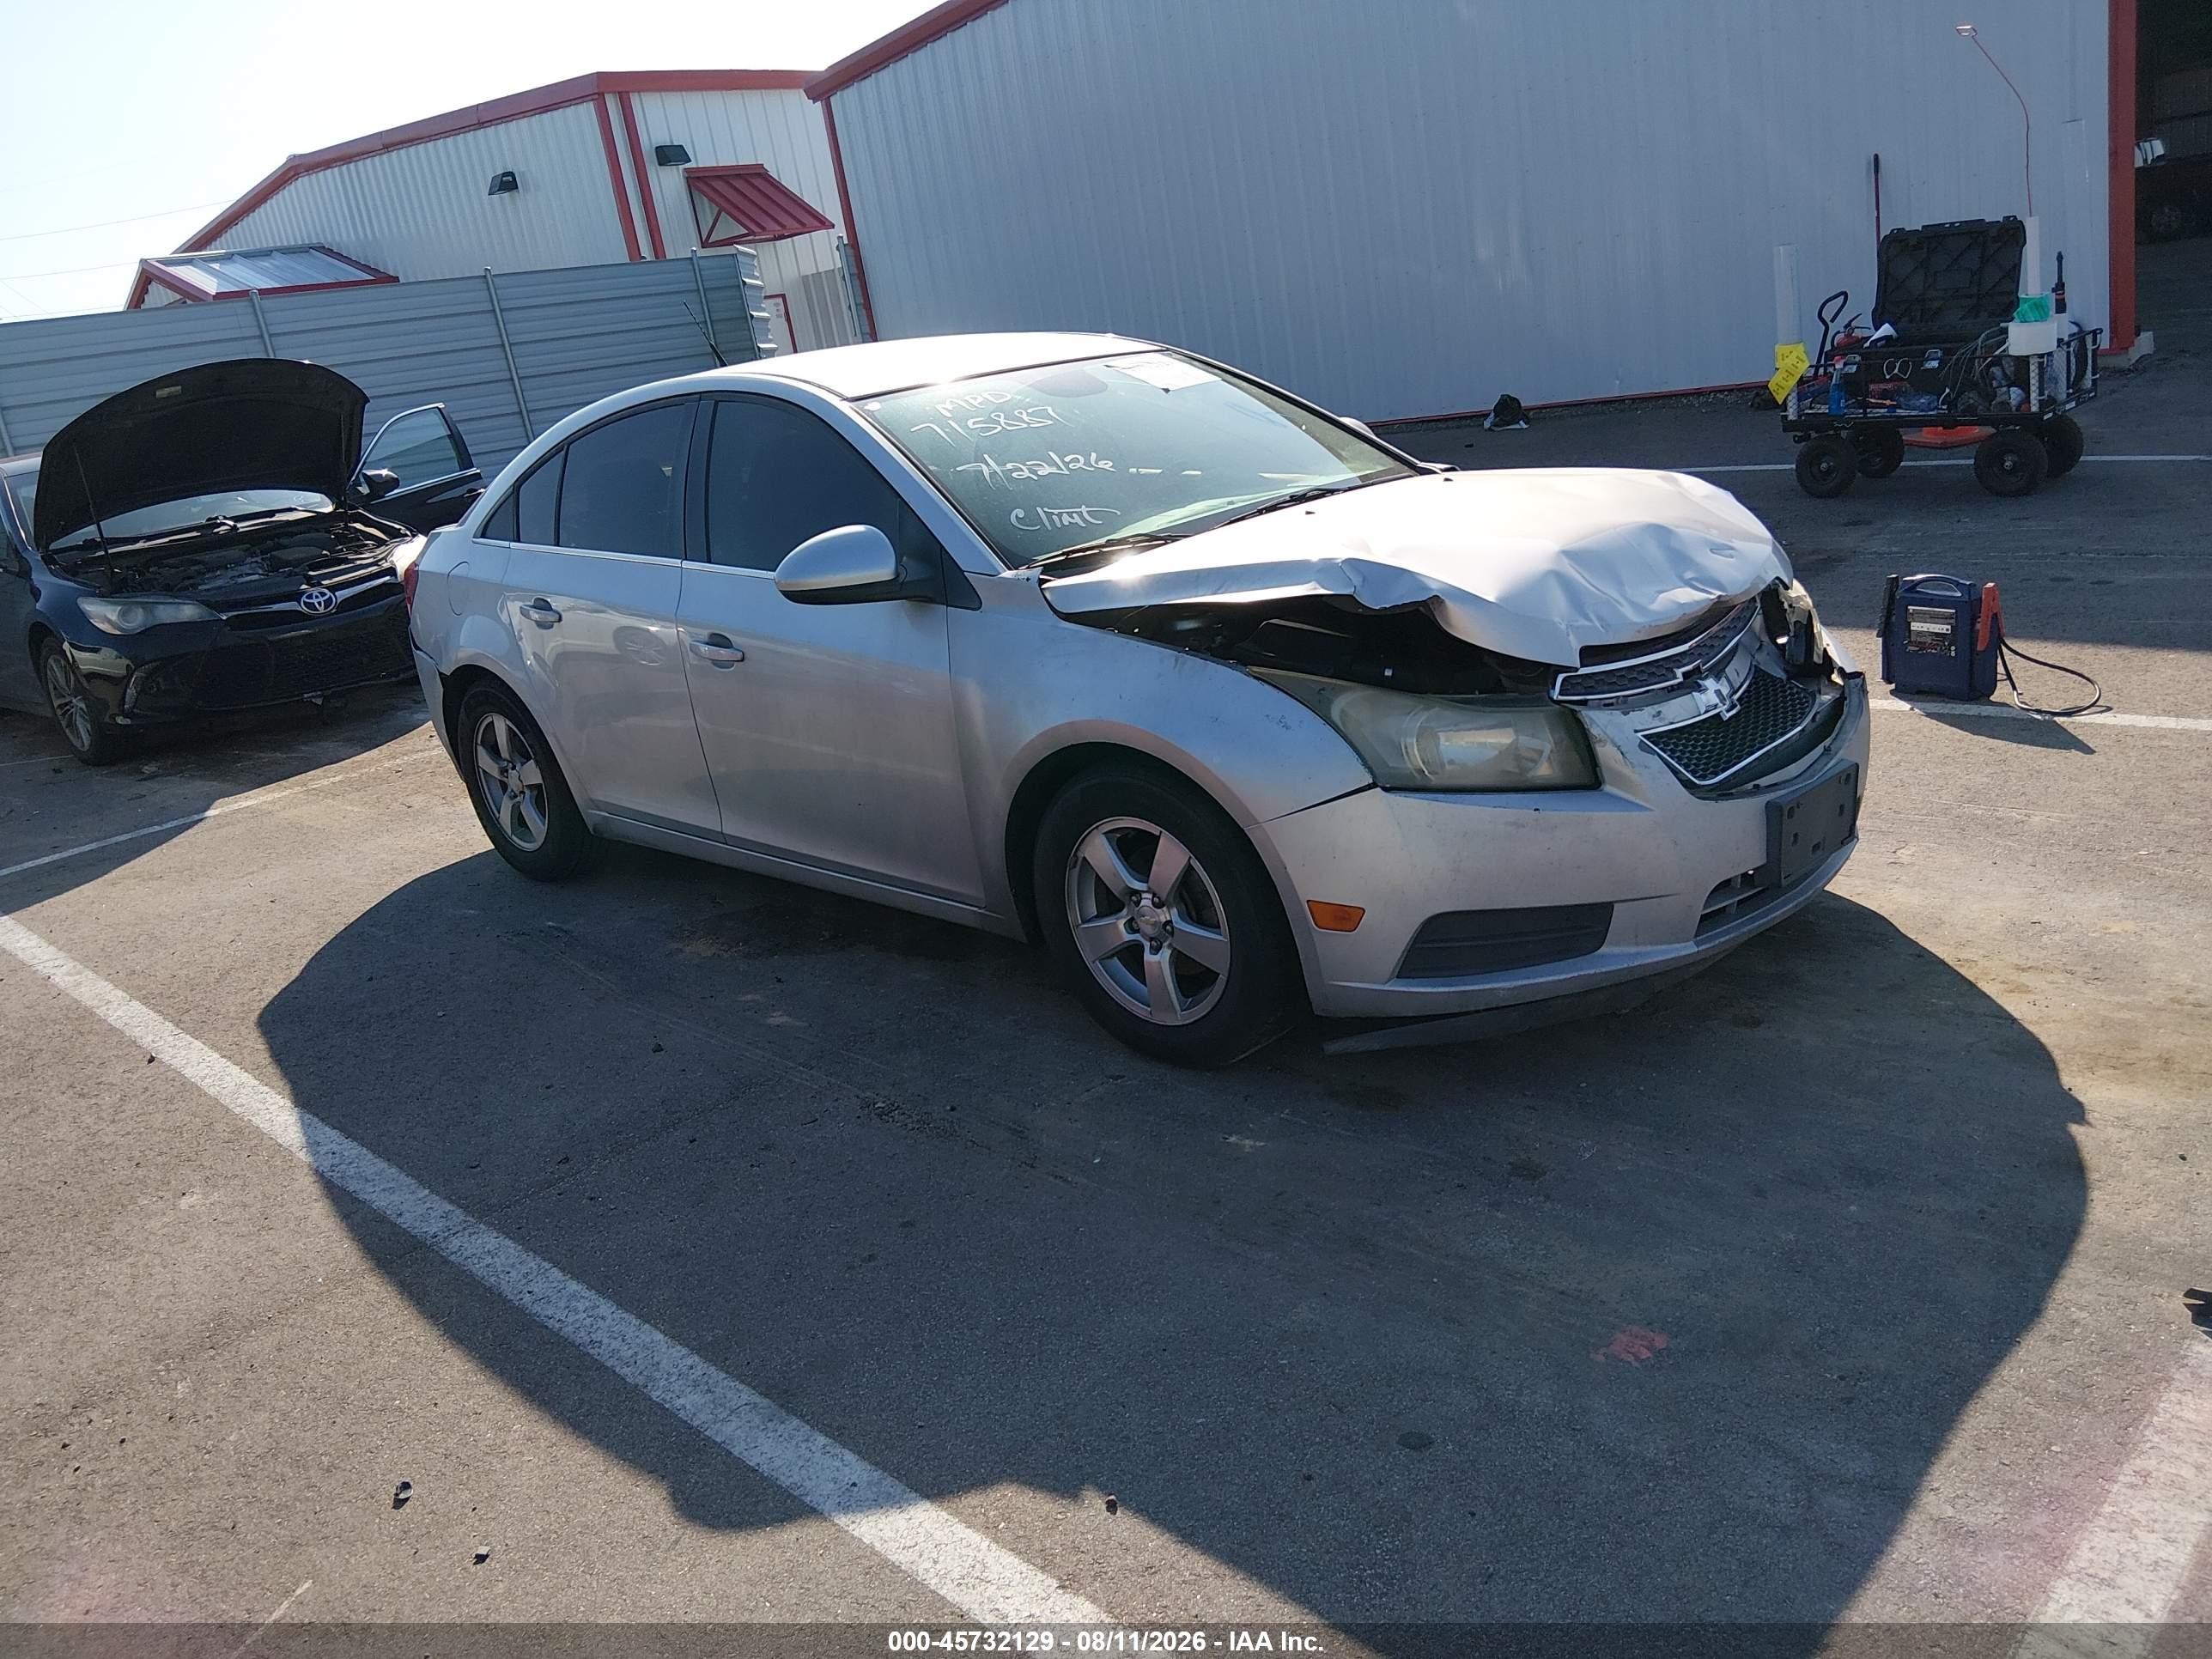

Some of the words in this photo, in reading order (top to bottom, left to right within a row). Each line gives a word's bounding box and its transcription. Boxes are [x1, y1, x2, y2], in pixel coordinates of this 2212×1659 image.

[934, 391, 1012, 417] MPD
[909, 405, 1072, 447] 715887
[955, 451, 1117, 490] 7/22/26
